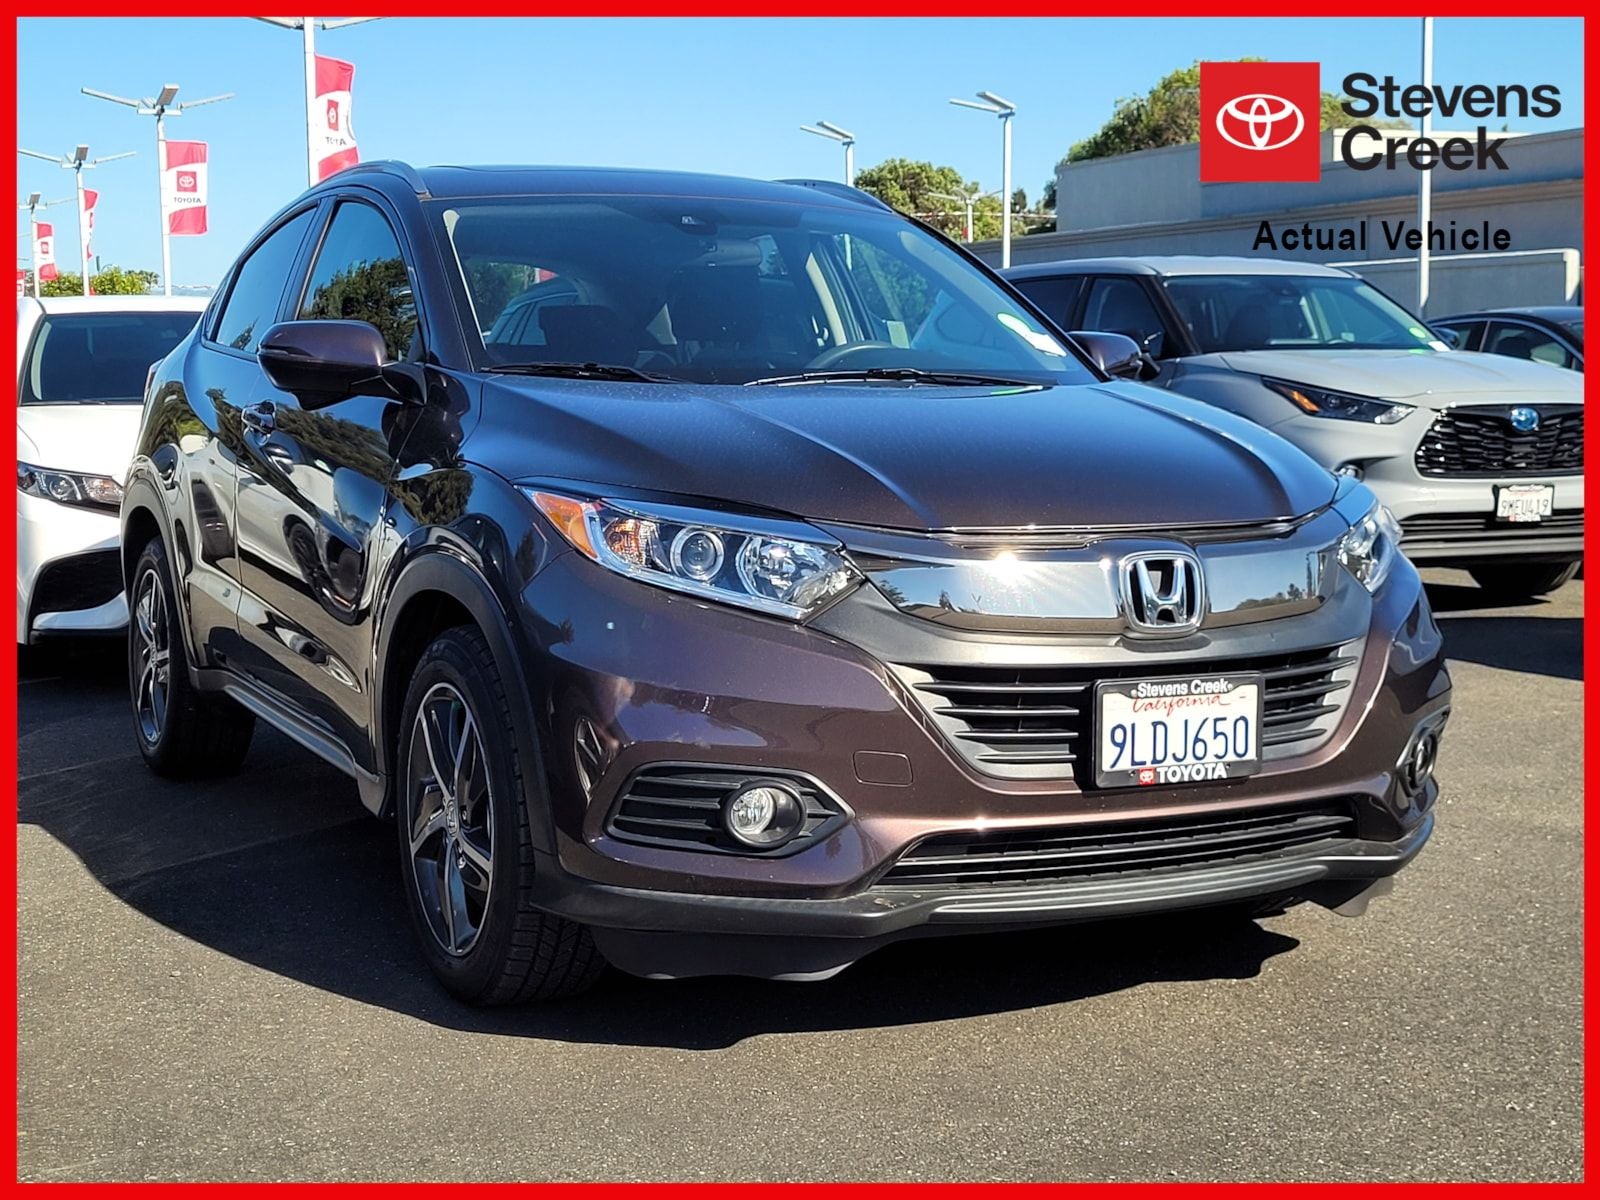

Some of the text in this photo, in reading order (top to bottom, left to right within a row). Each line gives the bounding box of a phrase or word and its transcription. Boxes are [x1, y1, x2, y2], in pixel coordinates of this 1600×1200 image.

[1137, 678, 1229, 698] Stevens Creek
[1132, 694, 1230, 717] California
[1110, 715, 1249, 769] 9LDJ650
[1156, 762, 1228, 784] TOYOTA
